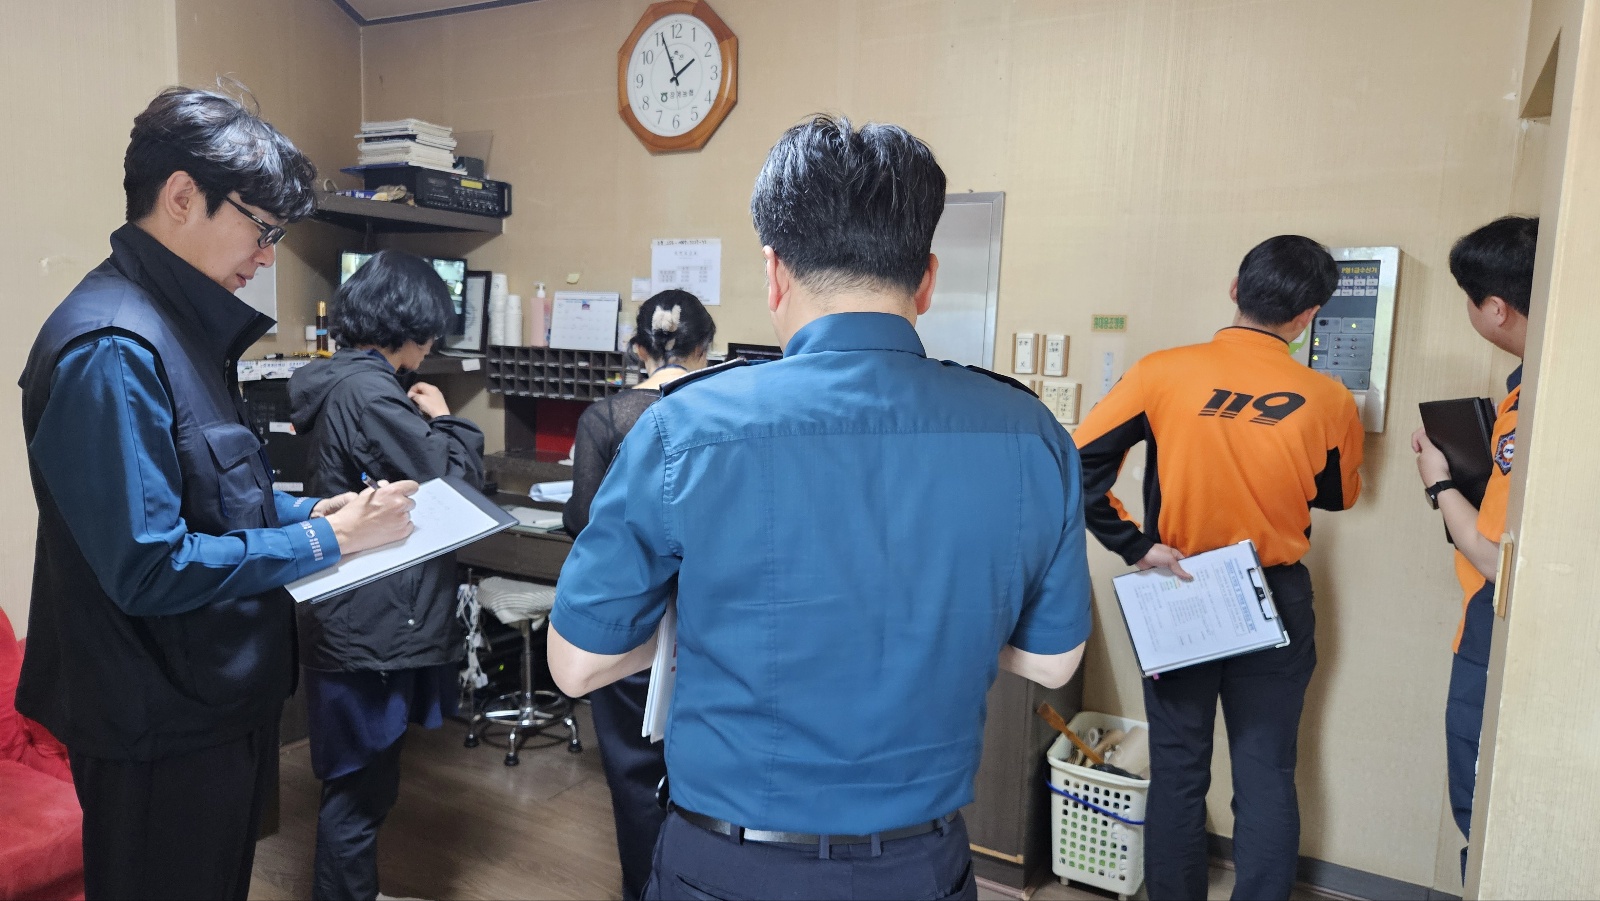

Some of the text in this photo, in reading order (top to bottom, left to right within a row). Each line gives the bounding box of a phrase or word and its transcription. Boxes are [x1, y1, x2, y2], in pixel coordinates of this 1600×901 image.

[671, 23, 683, 39] 12
[691, 27, 696, 42] 1
[655, 32, 665, 47] 11
[641, 49, 654, 65] 10
[704, 41, 712, 58] 2
[636, 73, 644, 89] 9
[710, 65, 718, 81] 3
[642, 95, 650, 111] 8
[704, 89, 712, 104] 4
[656, 110, 663, 125] 7
[672, 114, 680, 129] 6
[690, 106, 699, 121] 5
[1198, 388, 1306, 426] 119
